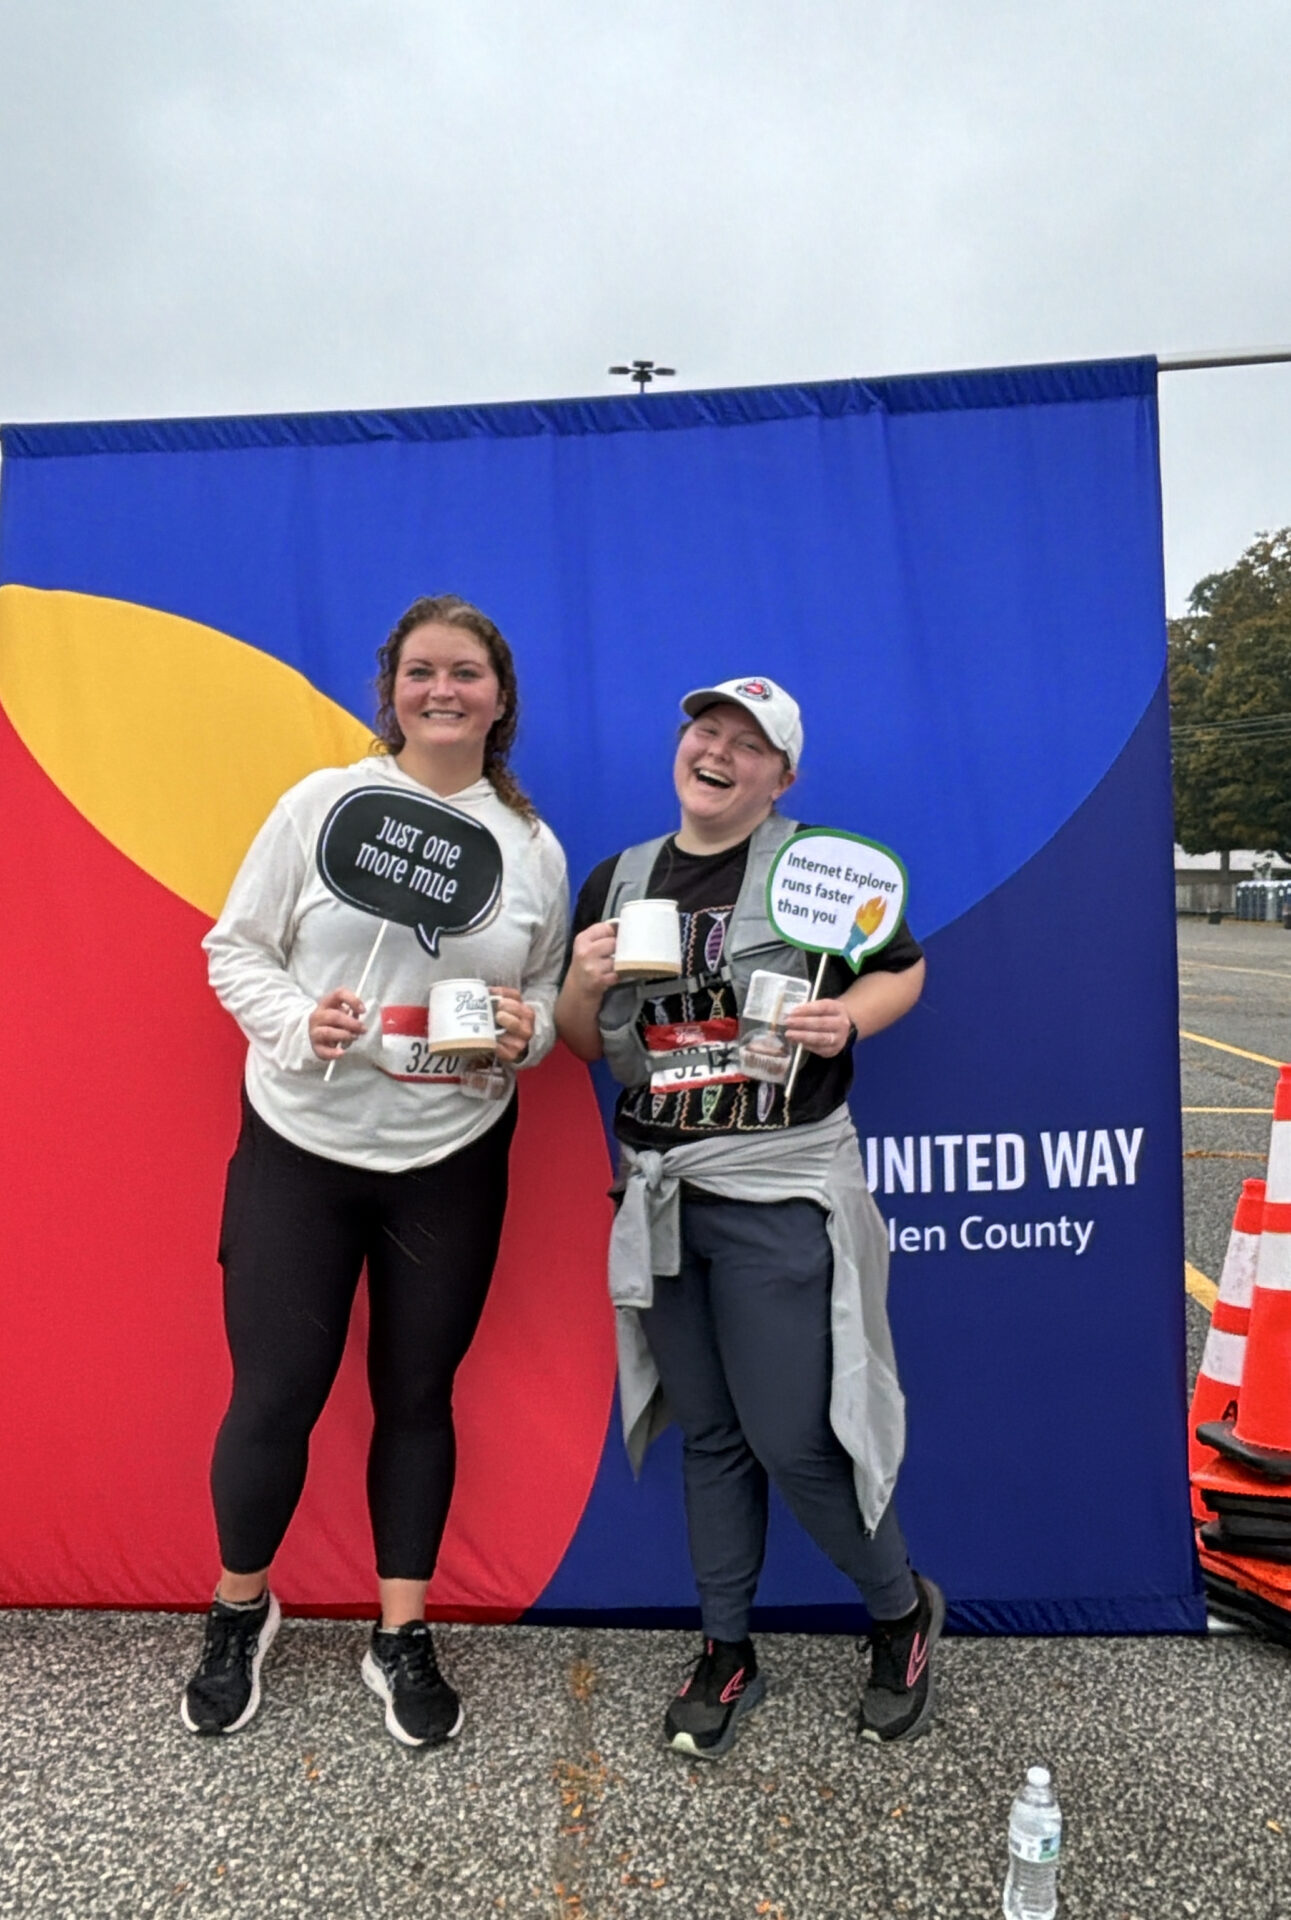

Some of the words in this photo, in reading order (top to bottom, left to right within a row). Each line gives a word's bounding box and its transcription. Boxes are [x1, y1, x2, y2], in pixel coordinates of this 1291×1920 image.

[782, 878, 812, 895] runs
[815, 883, 853, 905] faster
[787, 853, 842, 879] Internet
[844, 868, 898, 894] Explorer
[777, 899, 809, 919] than
[812, 910, 837, 925] you
[1040, 1127, 1144, 1189] WAY
[888, 1217, 946, 1252] len
[960, 1215, 1094, 1255] County
